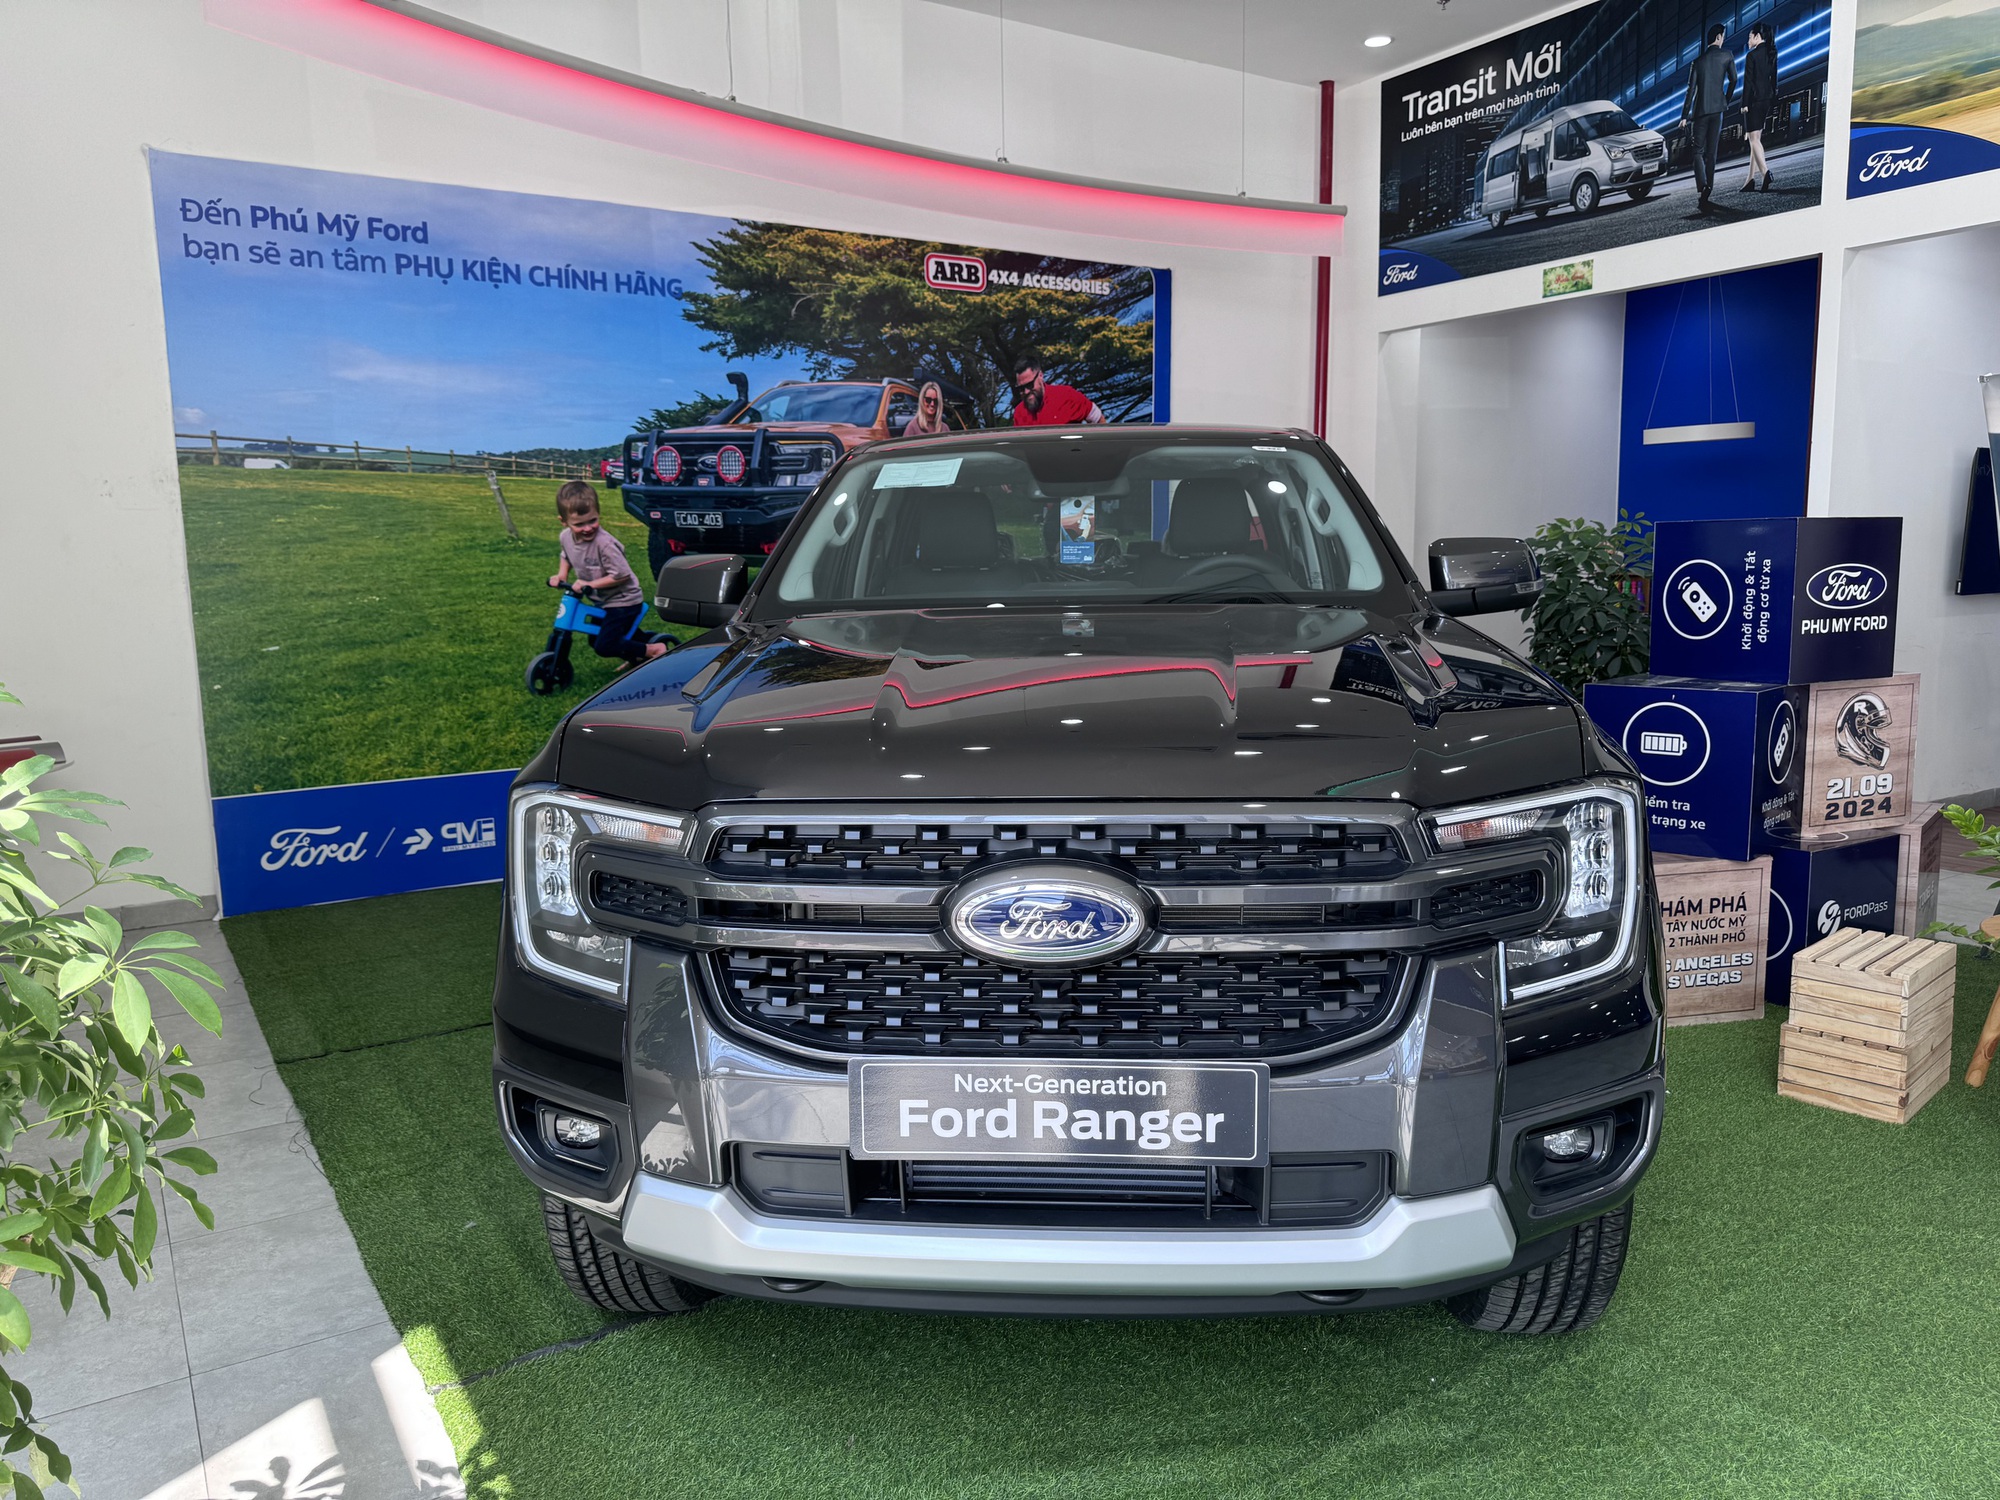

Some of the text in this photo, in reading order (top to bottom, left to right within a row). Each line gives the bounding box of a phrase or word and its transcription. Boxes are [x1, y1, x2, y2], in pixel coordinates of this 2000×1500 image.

[1401, 40, 1562, 123] Transit Mới
[1401, 82, 1561, 142] Luôn bên bạn trên mọi hành trình
[1859, 145, 1932, 182] Ford
[179, 198, 429, 244] Đến Phú Mỹ Ford
[182, 232, 684, 300] bạn sẽ an tâm PHỤ KIỆN CHÍNH HÃNG
[932, 260, 1111, 295] ARB 4X4 ACCESSORIES
[1382, 262, 1419, 285] Ford
[1741, 550, 1756, 650] Khởi động & Tắt
[1822, 570, 1873, 602] Ford
[1757, 559, 1771, 643] động cơ từ xa
[1801, 615, 1888, 634] PHU MY FORD
[1826, 773, 1893, 801] 21.09
[1645, 794, 1690, 811] iểm tra
[1825, 796, 1892, 820] 2024
[1651, 814, 1706, 830] trạng xe
[260, 825, 369, 872] Ford
[1660, 891, 1747, 917] HÁM PHÁ
[1843, 900, 1888, 921] FORDPass
[1000, 899, 1097, 940] Ford
[1666, 914, 1747, 933] TÂY NƯỚC MỸ
[1669, 929, 1746, 948] 2 THÀNH PHỐ
[1674, 952, 1754, 972] ANGELES
[1684, 970, 1743, 988] VEGAS
[954, 1072, 1167, 1097] Next-Generation
[899, 1098, 1225, 1150] Ford Ranger
